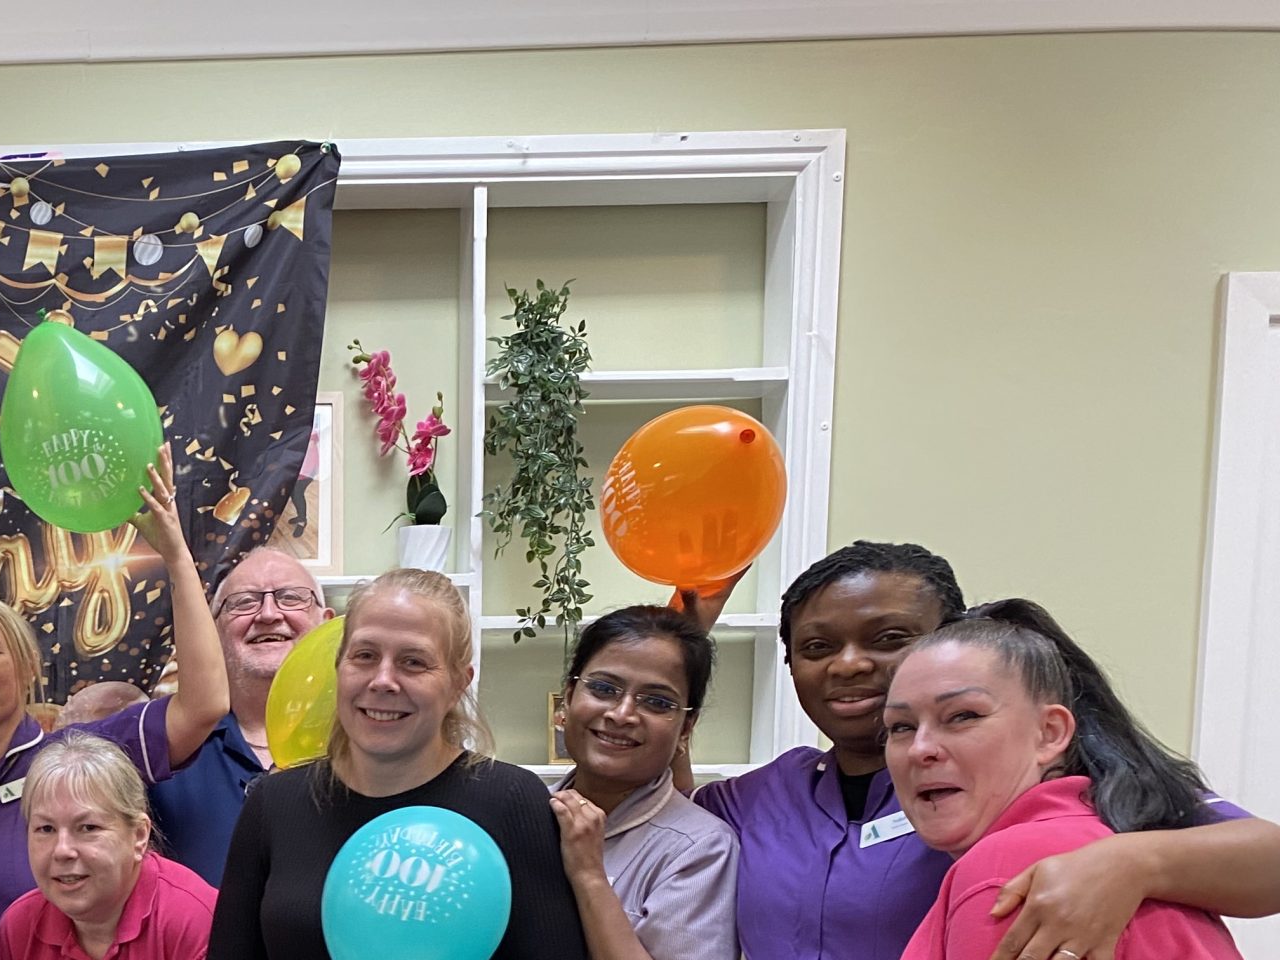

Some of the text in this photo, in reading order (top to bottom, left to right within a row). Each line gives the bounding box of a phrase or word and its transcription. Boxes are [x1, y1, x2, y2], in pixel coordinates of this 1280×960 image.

[42, 428, 91, 458] HAPPY
[619, 460, 643, 513] HAPPY
[364, 885, 428, 922] HAPPY
